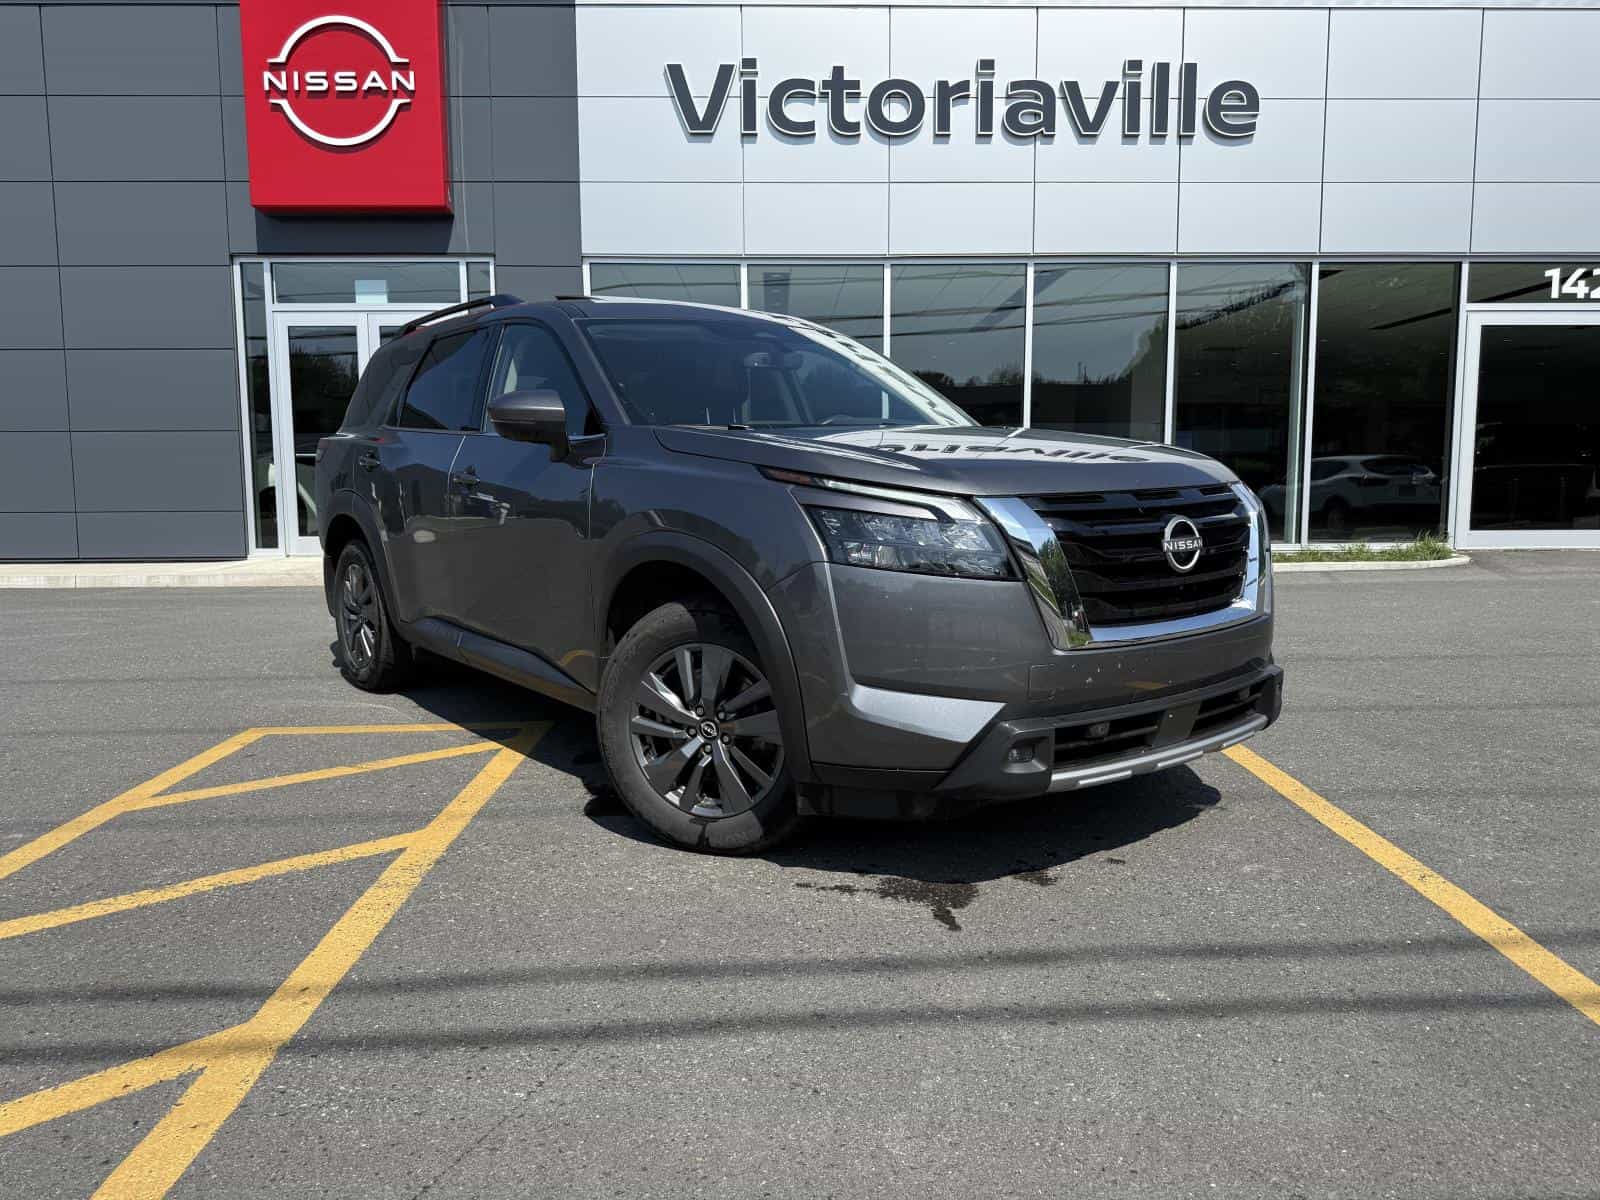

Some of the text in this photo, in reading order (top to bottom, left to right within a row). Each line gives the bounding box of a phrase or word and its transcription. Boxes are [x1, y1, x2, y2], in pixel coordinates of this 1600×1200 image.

[263, 70, 415, 91] NISSAN
[664, 57, 1260, 137] Victoriaville
[1163, 539, 1202, 552] NISSAN
